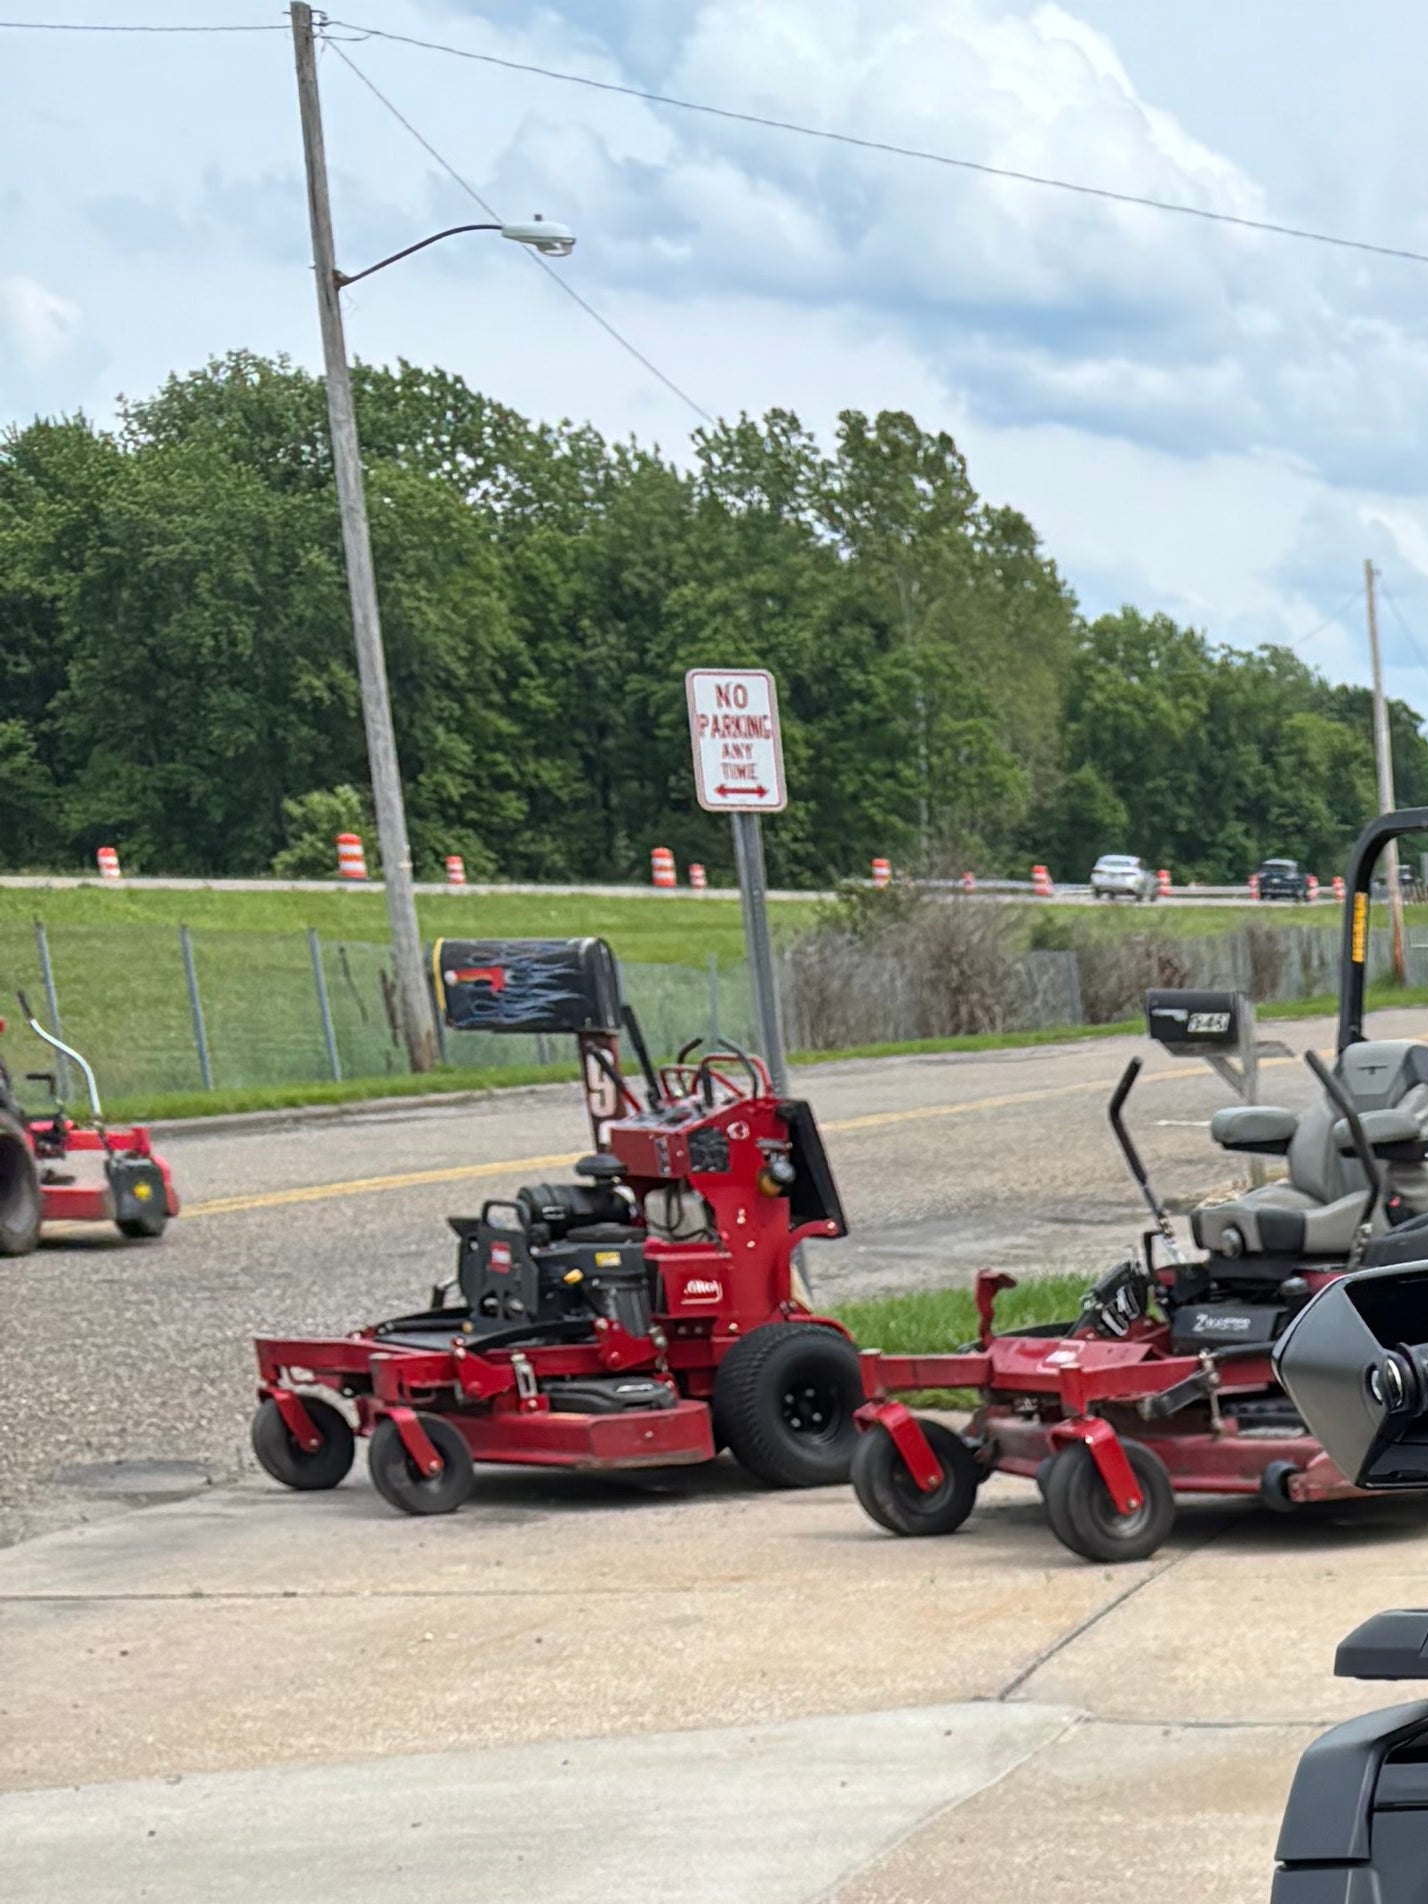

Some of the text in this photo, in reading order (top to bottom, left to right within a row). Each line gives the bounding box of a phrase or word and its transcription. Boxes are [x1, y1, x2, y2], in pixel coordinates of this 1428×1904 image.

[715, 682, 749, 709] NO
[698, 713, 771, 739] PARKING
[721, 743, 753, 760] ANY
[721, 762, 759, 780] TIME
